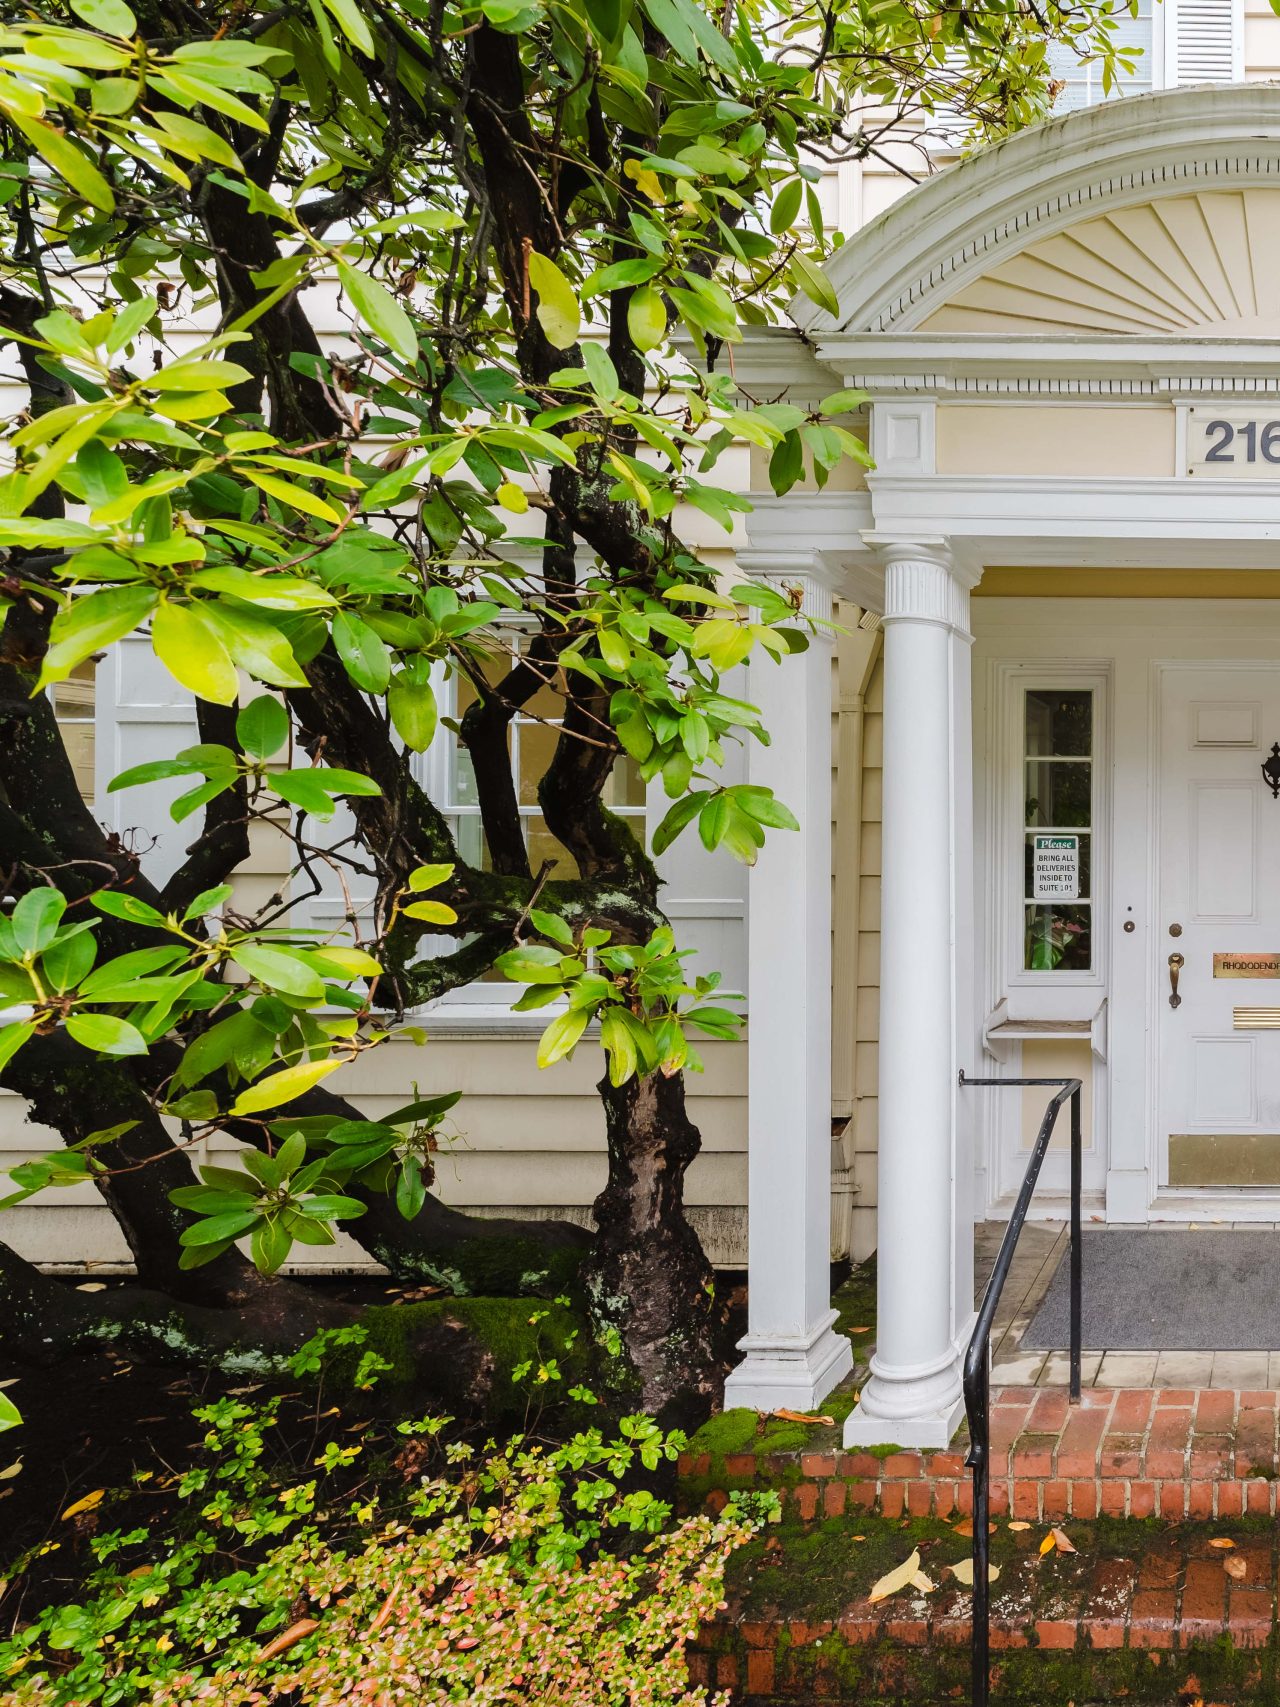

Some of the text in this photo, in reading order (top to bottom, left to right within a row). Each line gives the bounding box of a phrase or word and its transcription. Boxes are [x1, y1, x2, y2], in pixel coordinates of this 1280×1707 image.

[1040, 838, 1072, 849] Please
[1038, 854, 1075, 862] BRING ALL
[1036, 864, 1076, 872] DELIVERIES
[1039, 874, 1073, 882] INSIDE TO
[1038, 884, 1073, 892] SUITE 101
